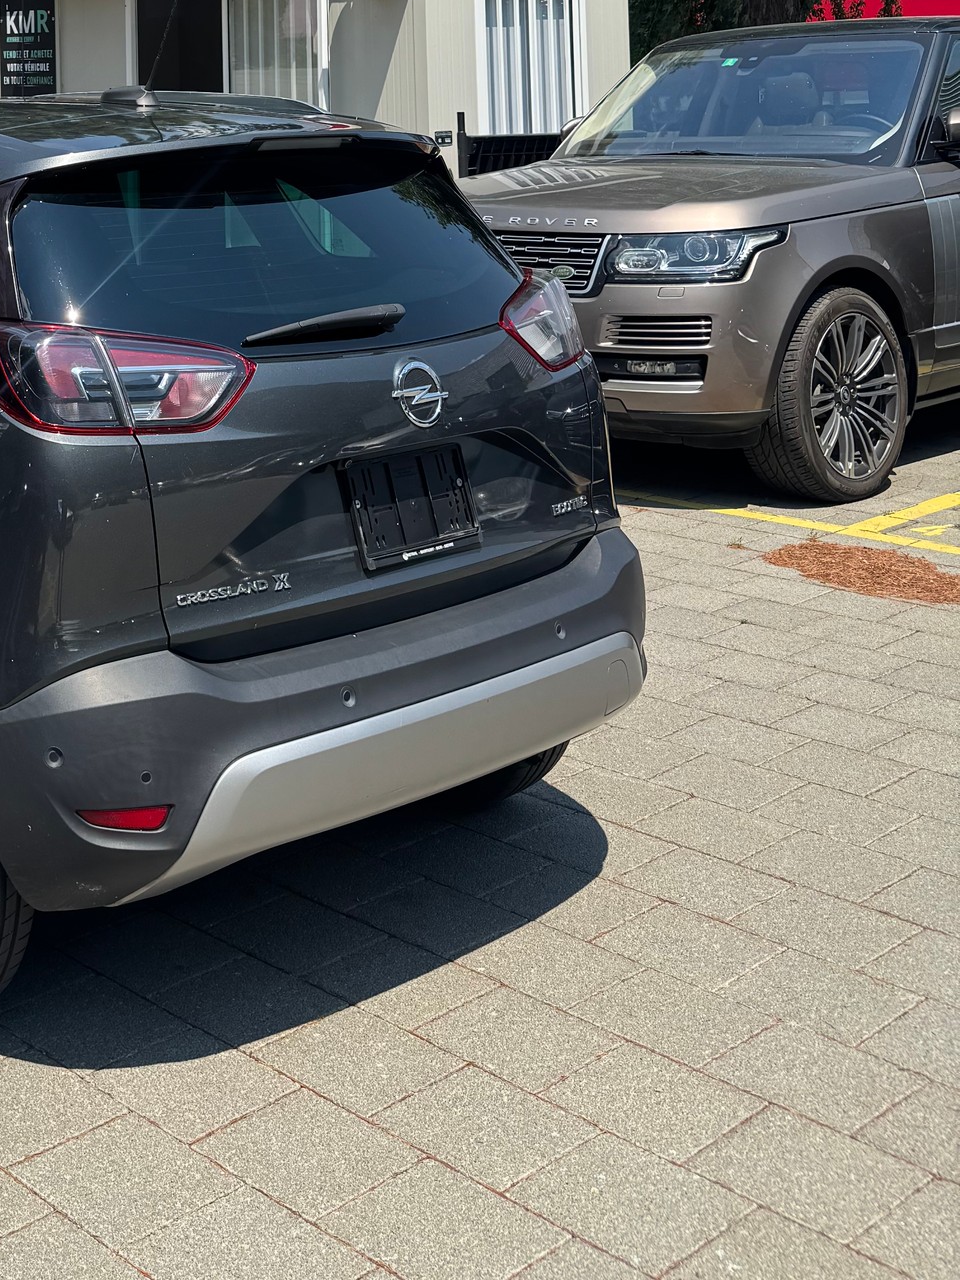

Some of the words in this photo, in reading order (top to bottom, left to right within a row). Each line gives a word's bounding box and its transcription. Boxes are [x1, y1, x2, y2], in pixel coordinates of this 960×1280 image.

[6, 9, 50, 35] KMR
[23, 49, 30, 59] ET
[31, 49, 53, 58] ACHETEZ
[7, 62, 23, 72] VOTRE
[24, 60, 50, 72] VÉHICULE
[3, 76, 10, 85] EN
[27, 76, 54, 85] CONFIANCE
[508, 216, 599, 227] ROVER
[176, 579, 269, 607] CROSSLAND
[272, 572, 292, 591] X
